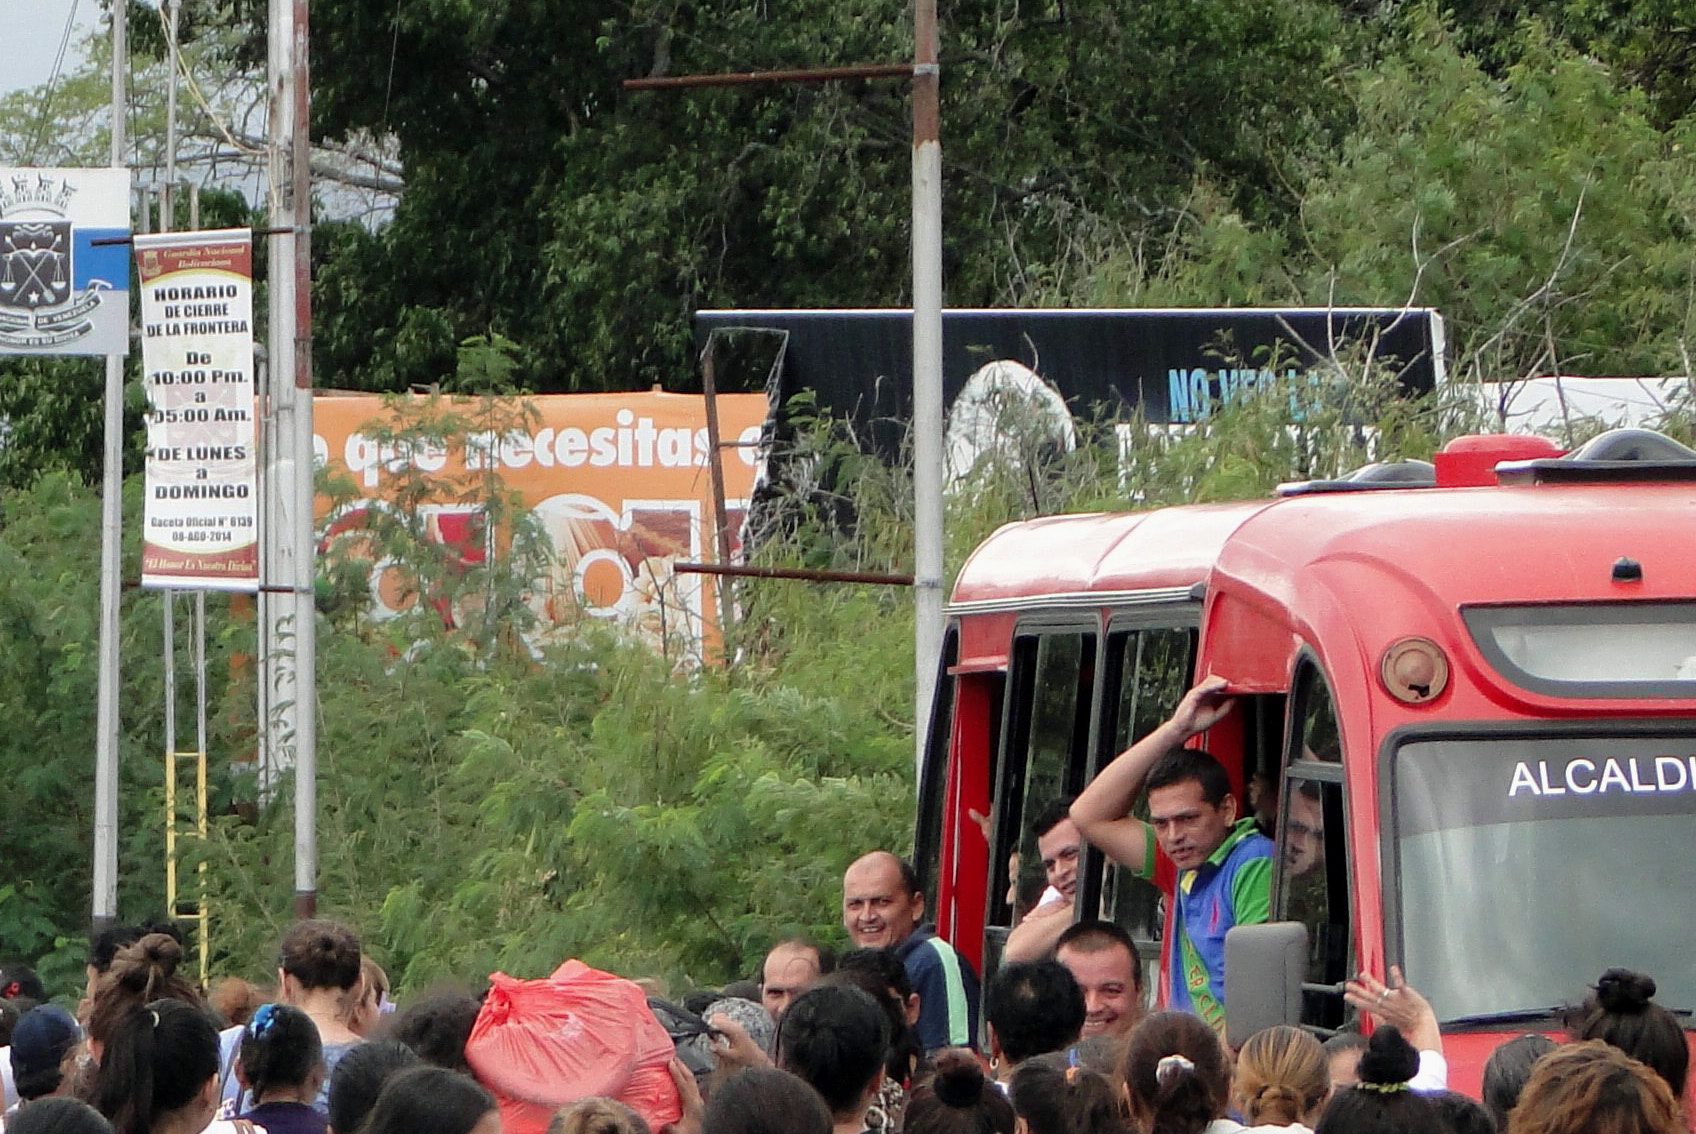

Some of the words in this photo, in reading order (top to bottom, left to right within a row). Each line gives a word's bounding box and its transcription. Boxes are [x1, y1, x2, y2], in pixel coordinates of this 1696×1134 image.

[154, 284, 238, 302] HORARIO
[165, 305, 181, 319] DE
[184, 303, 229, 318] CIERRE
[147, 324, 162, 338] DE
[166, 323, 181, 337] LA
[184, 320, 248, 336] FRONTERA
[186, 351, 212, 366] De
[153, 370, 206, 385] 10:00
[211, 370, 248, 384] Pm.
[194, 391, 206, 403] a
[1168, 367, 1211, 422] NO
[214, 408, 251, 422] Am.
[158, 447, 183, 462] DE
[187, 446, 247, 461] LUNES
[195, 467, 208, 480] a
[155, 483, 250, 500] DOMINGO
[151, 516, 184, 527] Gaceta
